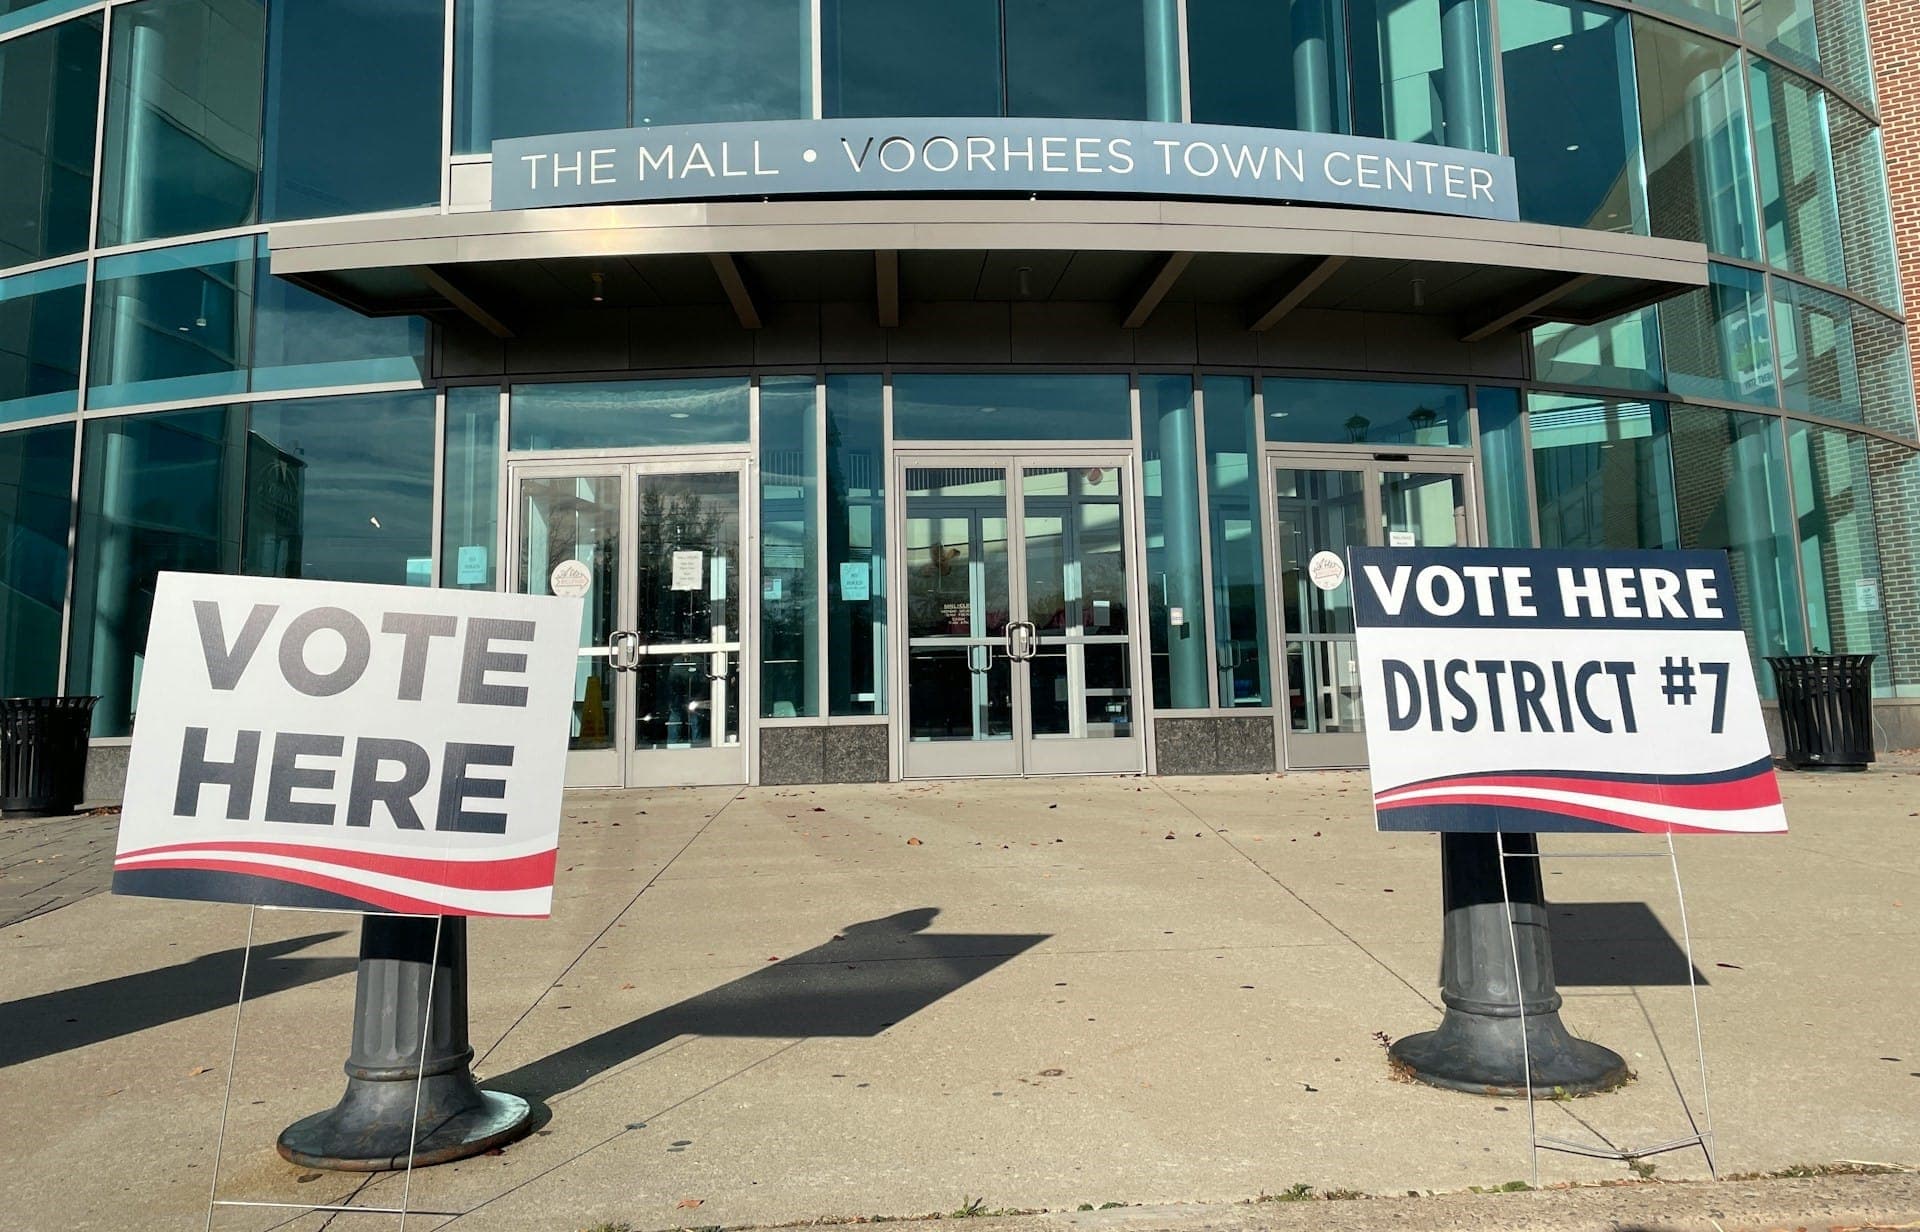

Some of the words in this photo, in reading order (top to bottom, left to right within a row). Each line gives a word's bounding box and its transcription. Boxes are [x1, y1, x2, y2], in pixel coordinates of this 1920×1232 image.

[521, 149, 617, 191] THE
[638, 141, 779, 181] MALL
[841, 136, 1135, 174] VOORHEES
[1153, 140, 1304, 182] TOWN
[1323, 151, 1495, 203] CENTER
[1363, 565, 1538, 617] VOTE
[1557, 567, 1724, 619] HERE
[193, 600, 536, 707] VOTE
[1382, 658, 1639, 734] DISTRICT
[1659, 656, 1730, 734] #7
[173, 726, 515, 835] HERE
